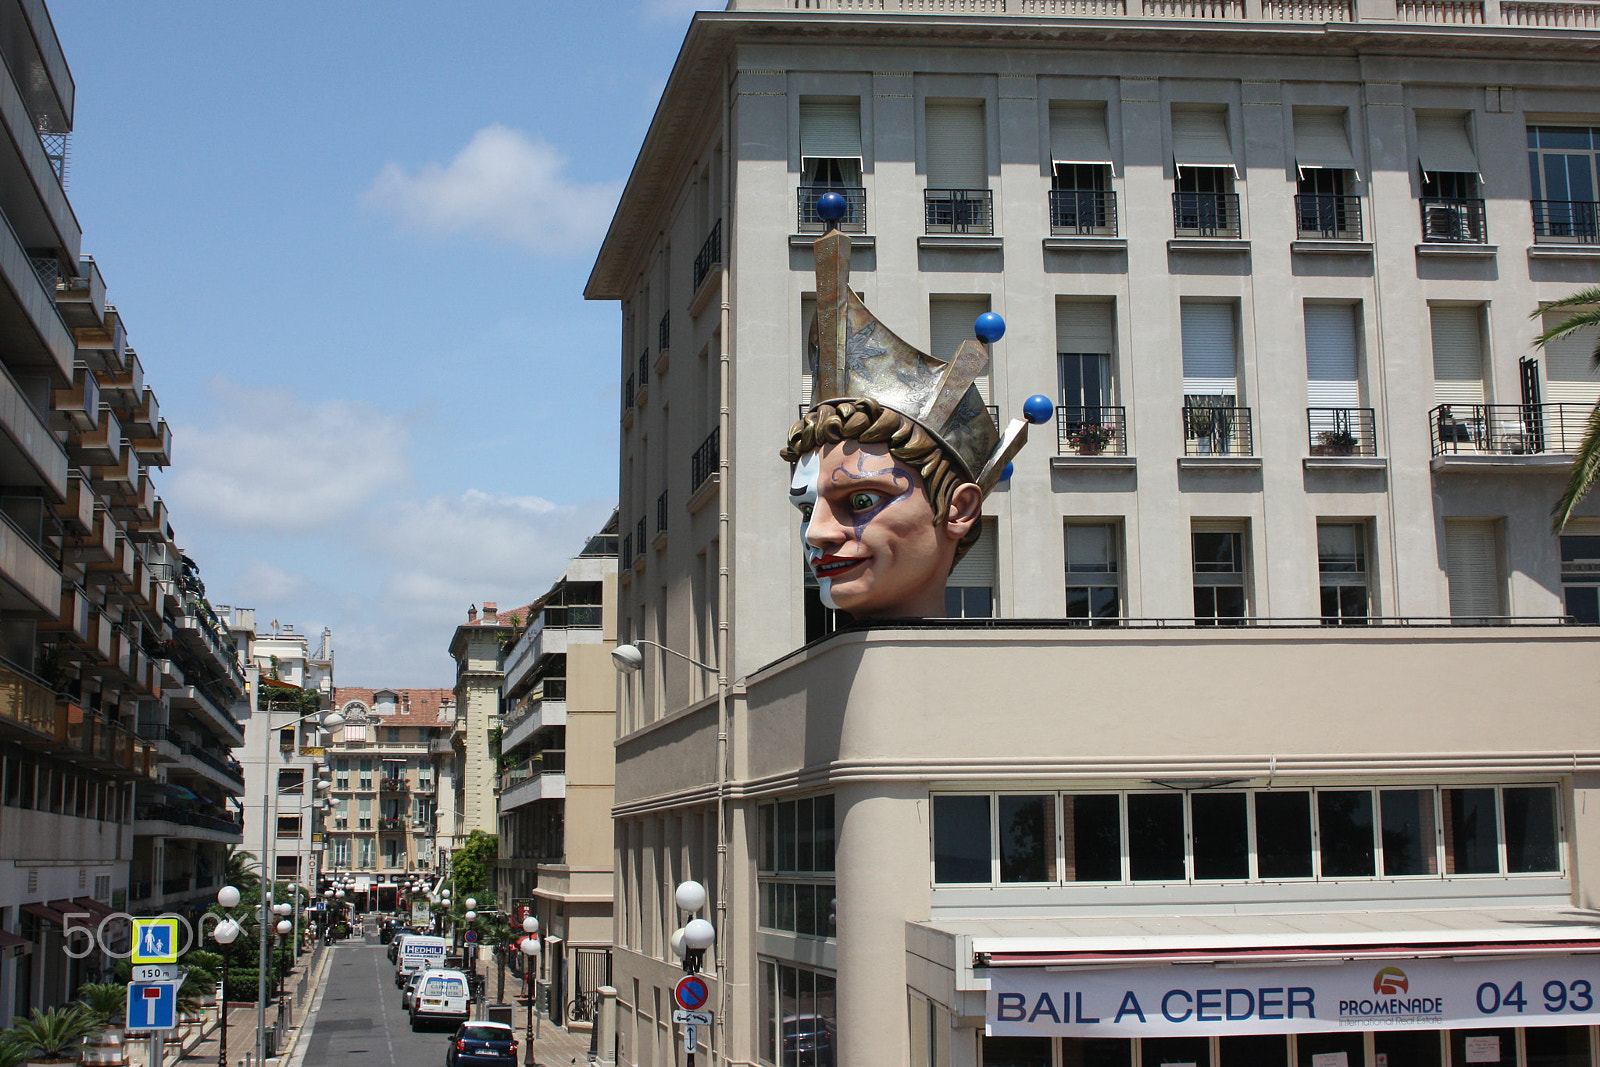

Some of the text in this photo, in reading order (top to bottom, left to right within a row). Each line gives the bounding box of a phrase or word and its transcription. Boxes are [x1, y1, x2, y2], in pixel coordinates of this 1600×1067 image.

[308, 854, 316, 888] HOTEL
[406, 945, 442, 955] HEDHILI
[141, 968, 161, 978] 150
[997, 986, 1316, 1024] BAIL A CEDER
[1475, 979, 1594, 1014] 04 93
[1339, 997, 1443, 1016] PROMENADE
[1339, 1015, 1443, 1027] International Real Estate
